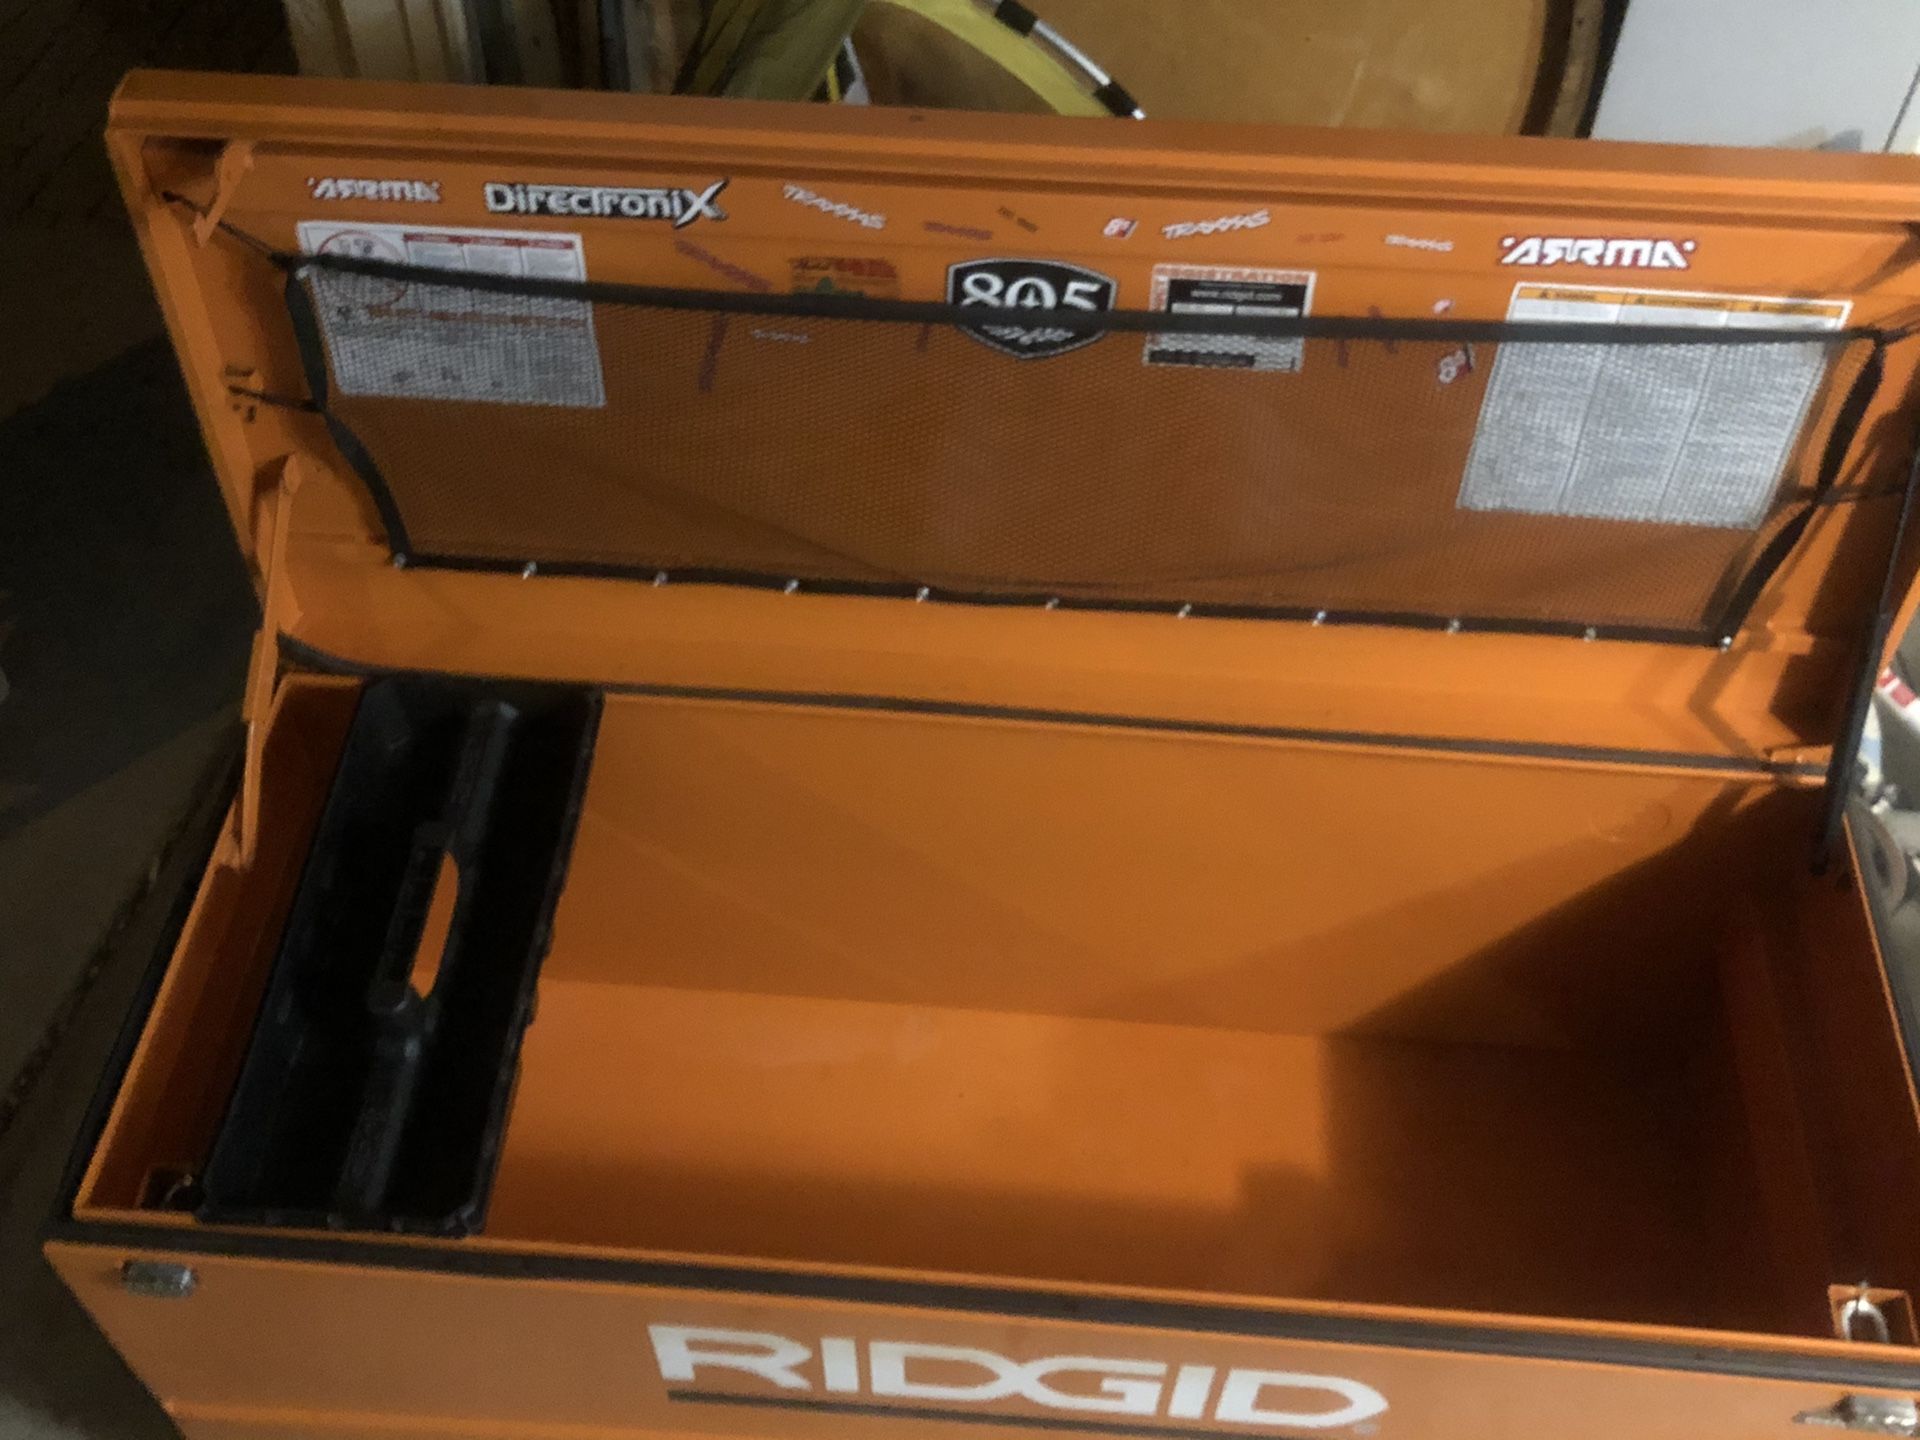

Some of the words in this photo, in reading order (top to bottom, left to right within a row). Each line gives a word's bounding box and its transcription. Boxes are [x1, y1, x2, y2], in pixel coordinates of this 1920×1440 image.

[484, 178, 729, 229] DirectroniX
[1501, 237, 1696, 270] ARRMA
[647, 1324, 1389, 1429] RIDGID
